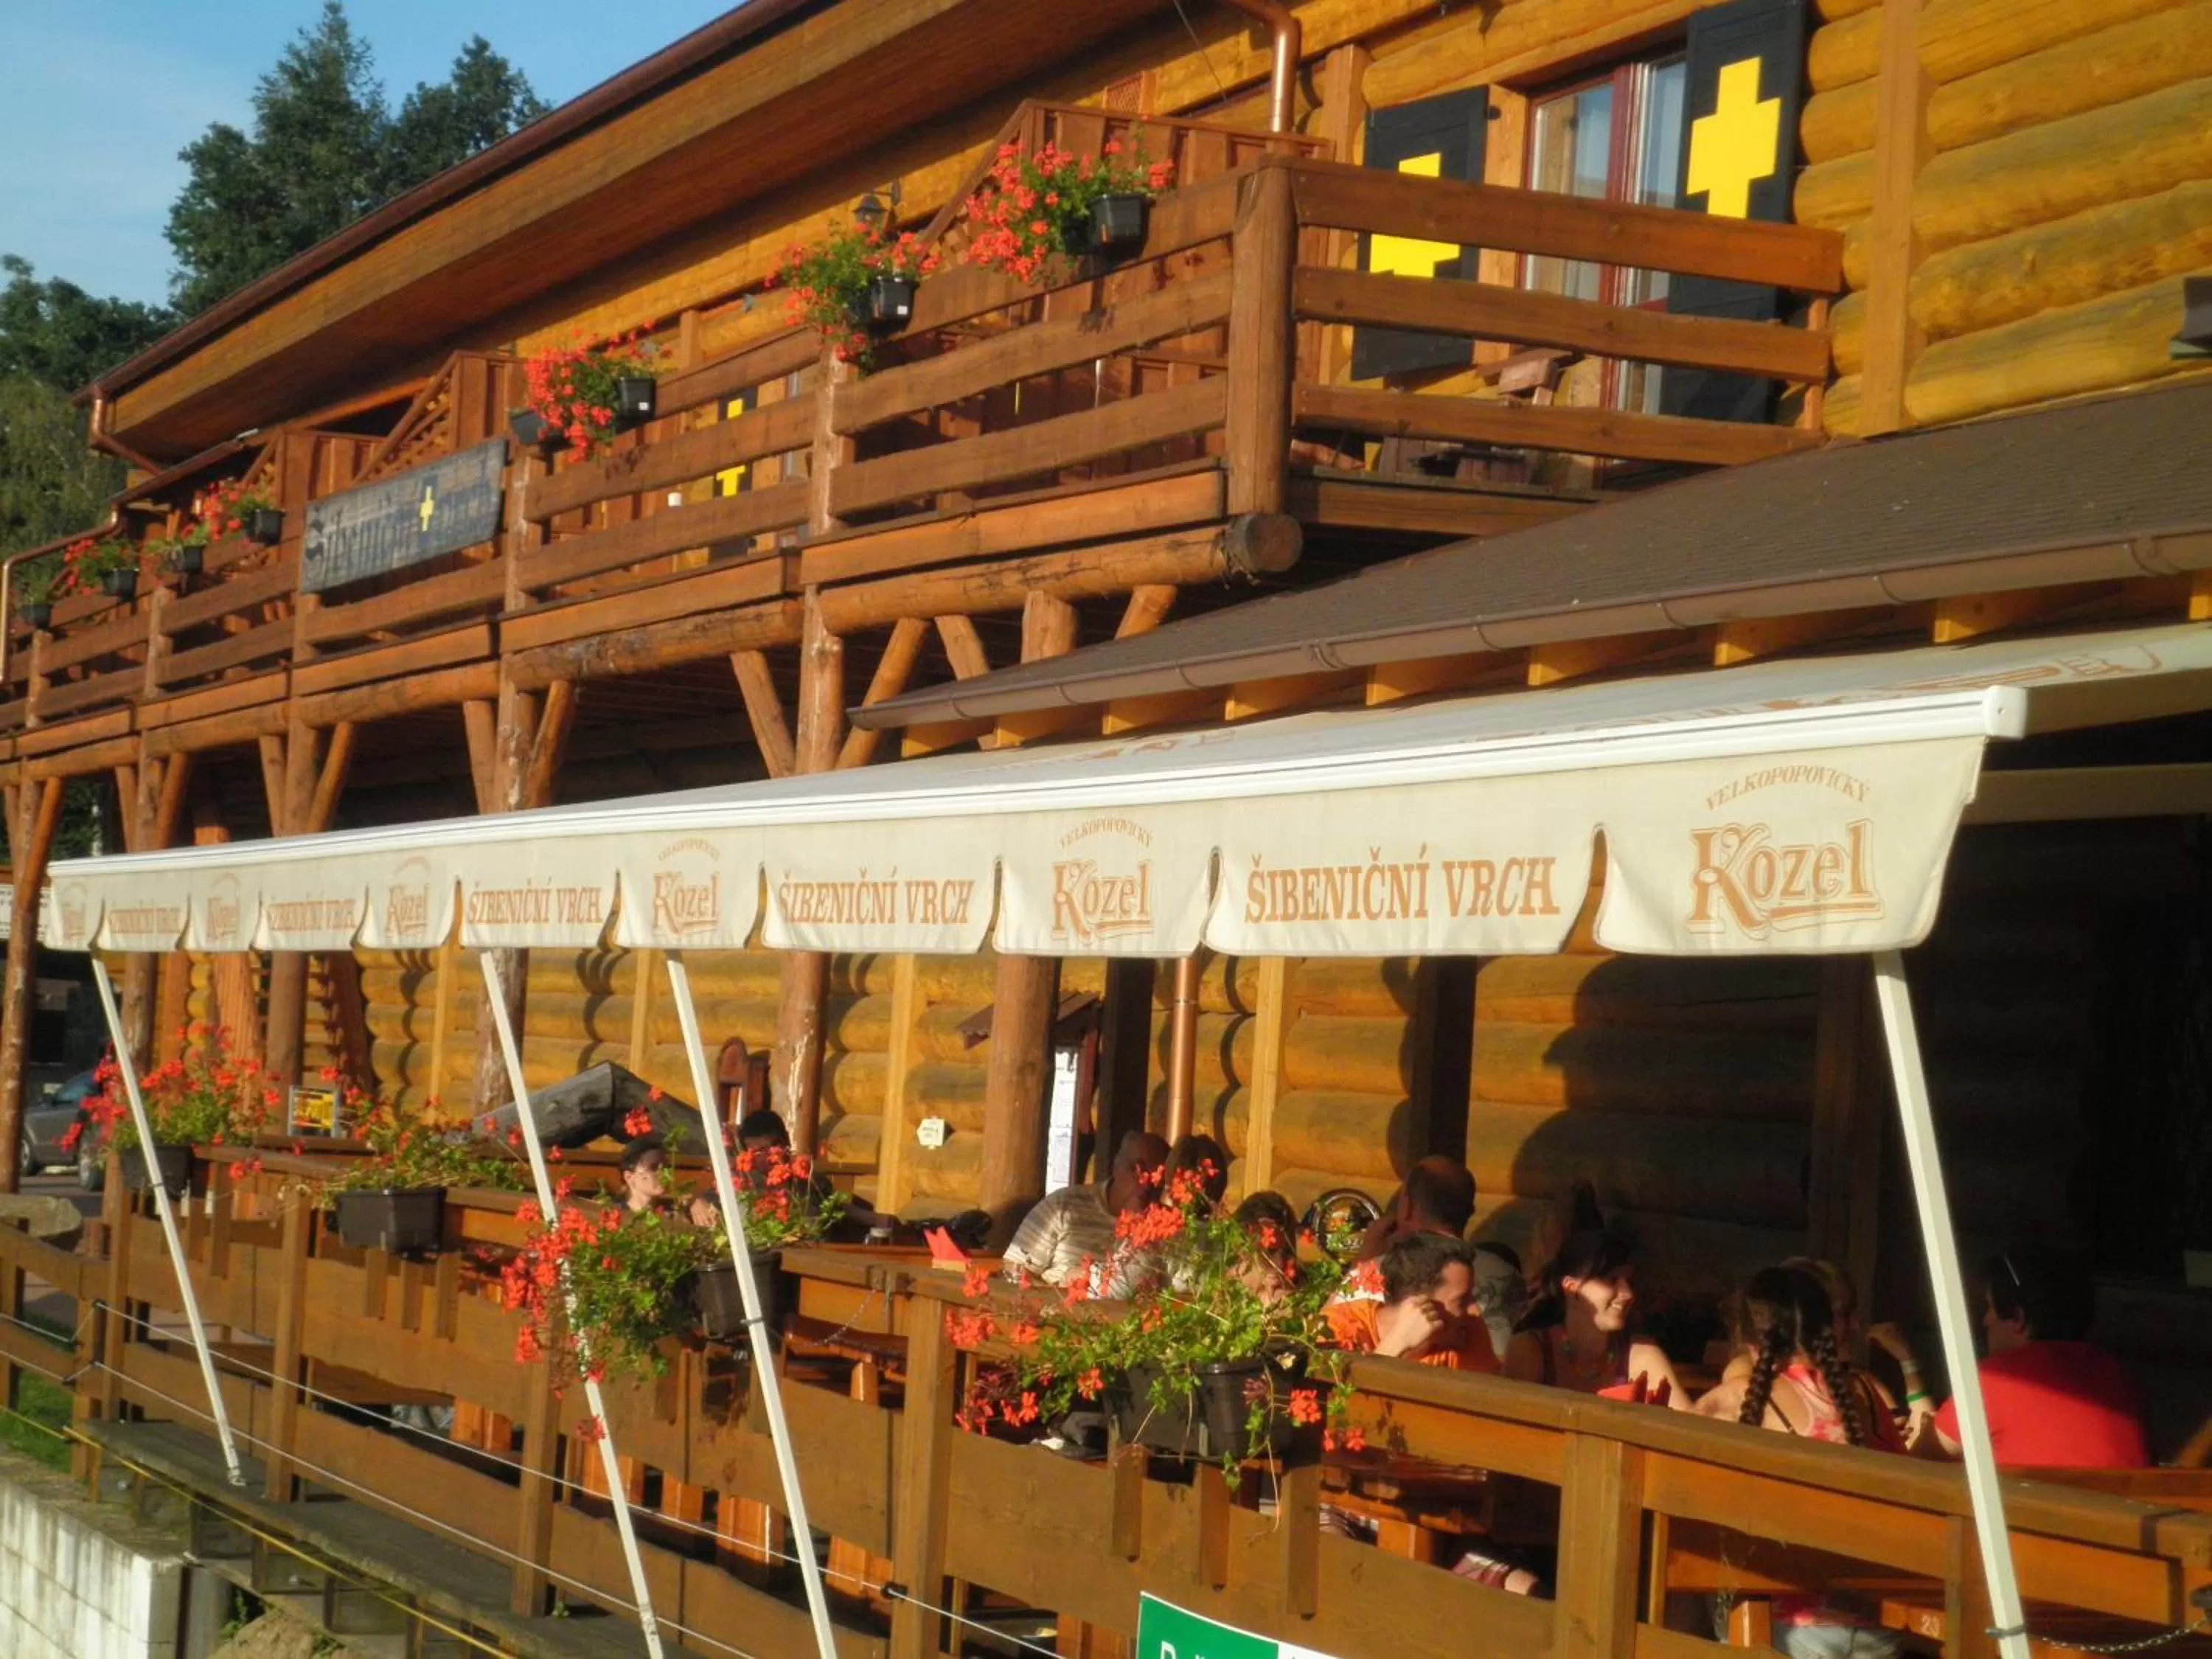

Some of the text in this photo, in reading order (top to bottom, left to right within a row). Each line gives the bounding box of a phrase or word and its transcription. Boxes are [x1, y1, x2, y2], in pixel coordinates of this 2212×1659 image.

[1705, 764, 1871, 810] VELKOPOPOVICKÝ
[557, 887, 602, 924] VRCH
[652, 871, 721, 941] Kozel
[779, 866, 975, 925] ŠIBENIČNÍ VRCH
[1051, 859, 1154, 946] Kozel
[1244, 842, 1561, 924] ŠIBENIČNÍ VRCH
[1684, 817, 1885, 941] Kozel
